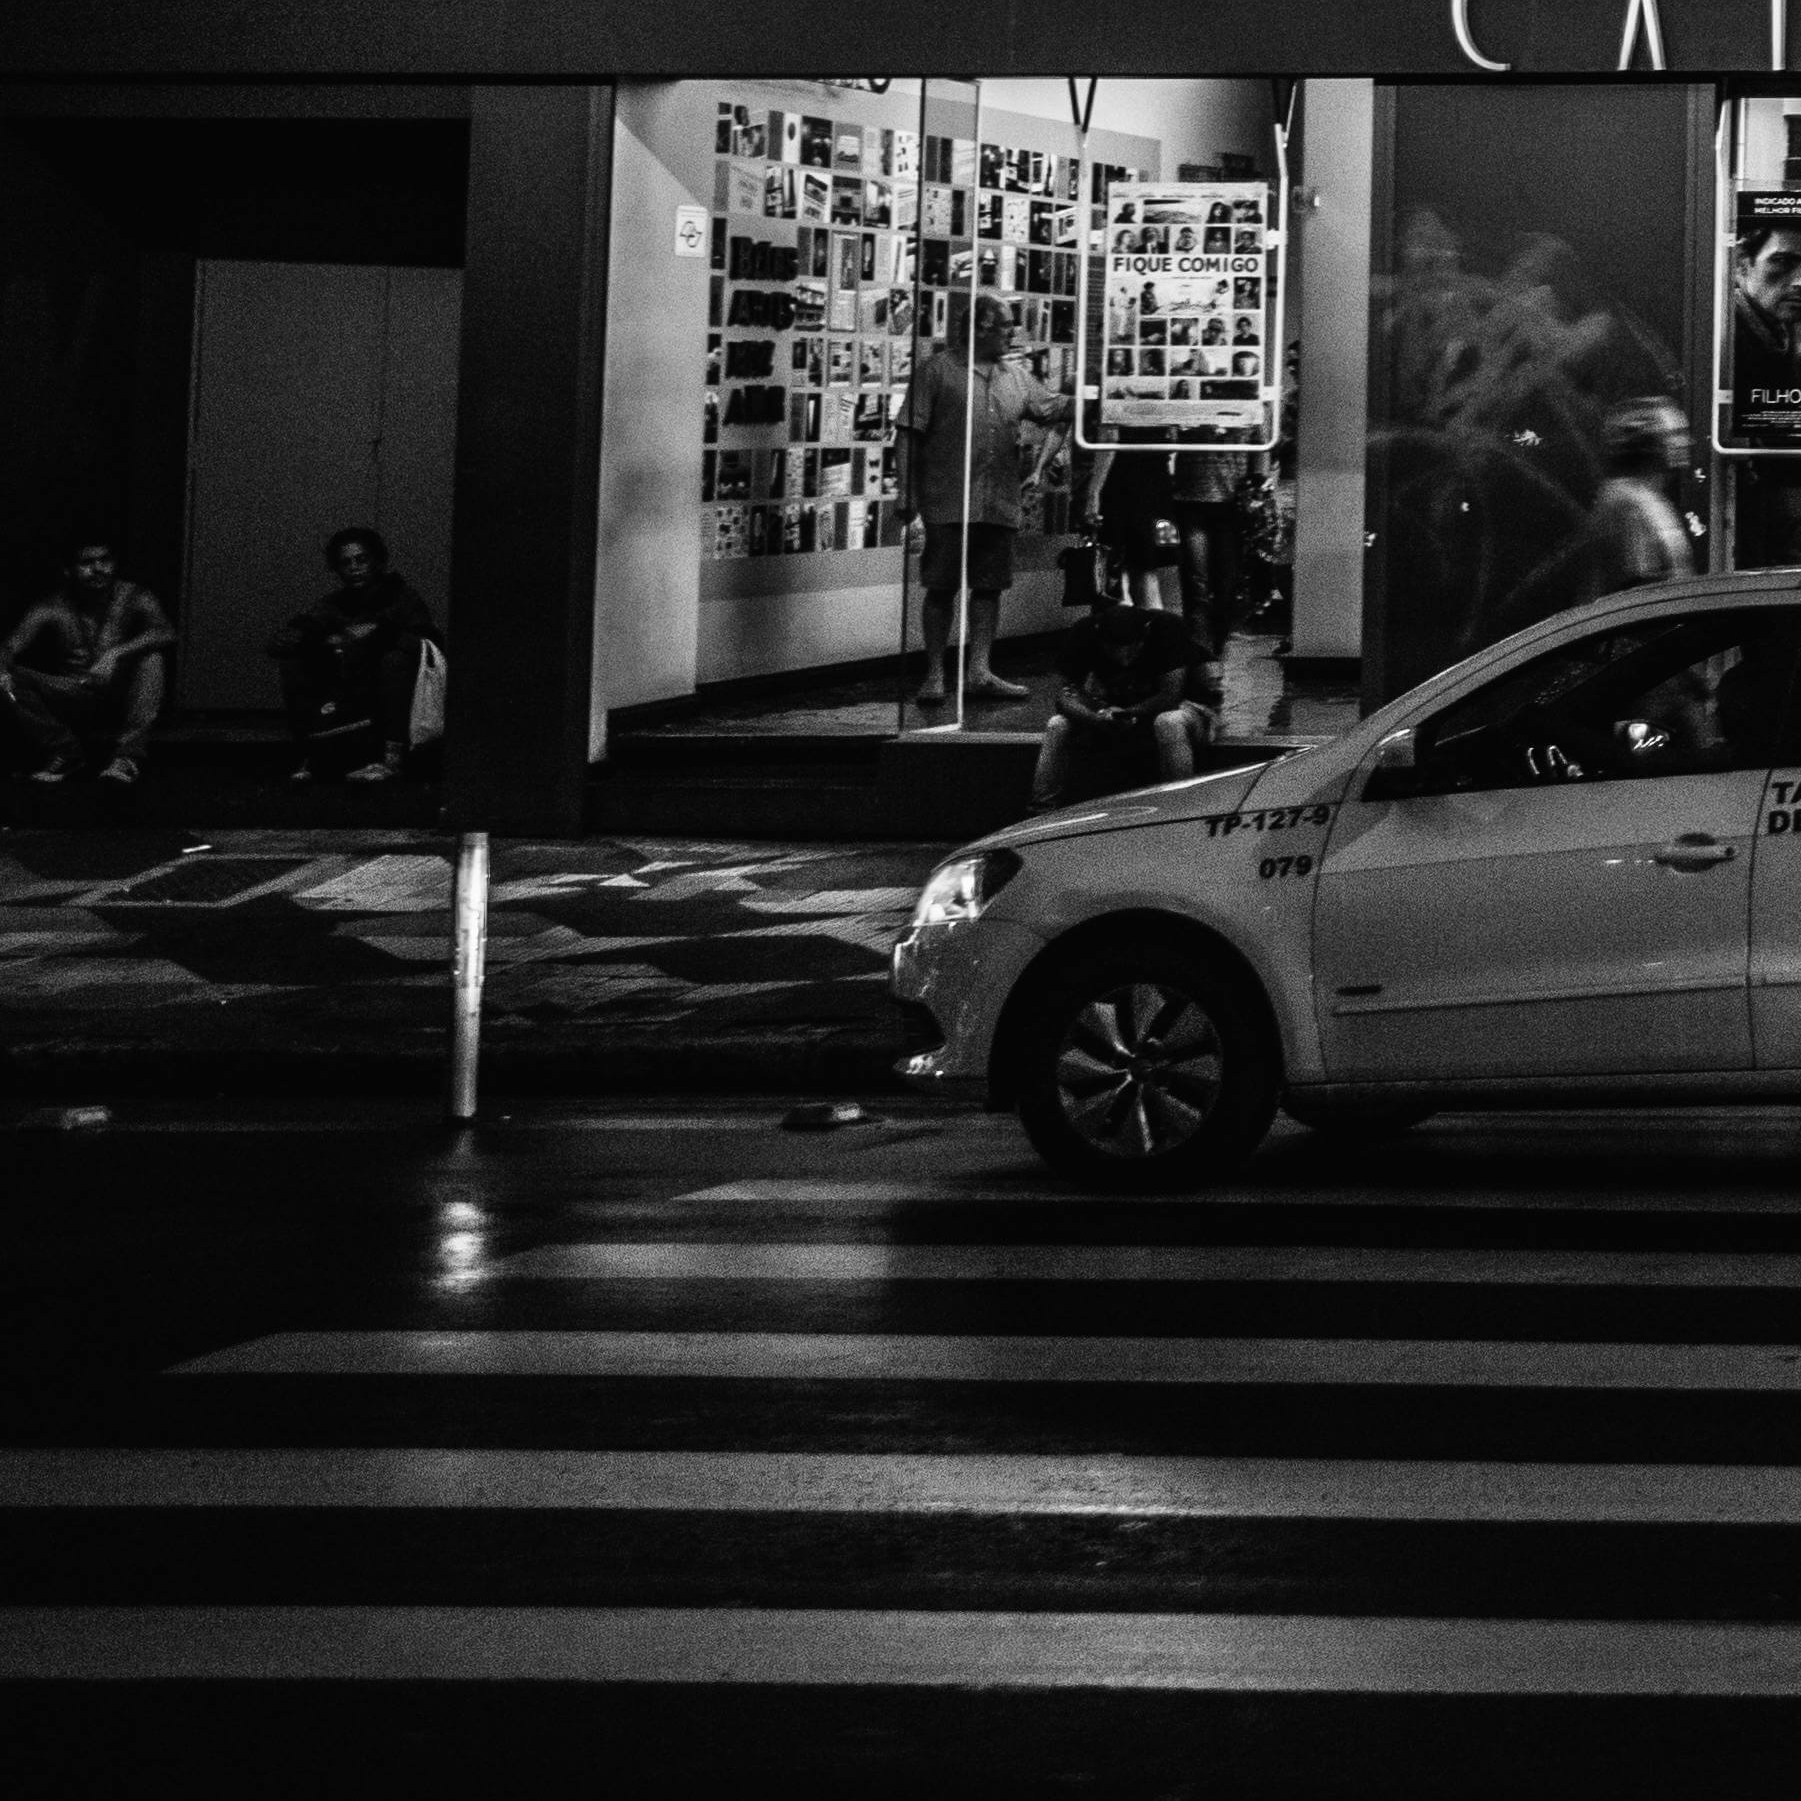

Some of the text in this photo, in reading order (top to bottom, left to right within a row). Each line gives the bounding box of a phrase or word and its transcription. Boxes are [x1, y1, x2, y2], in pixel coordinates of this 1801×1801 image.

[1113, 256, 1259, 275] FIQUE COMIGO
[1204, 804, 1330, 837] TP-127-9
[1258, 854, 1313, 880] 079
